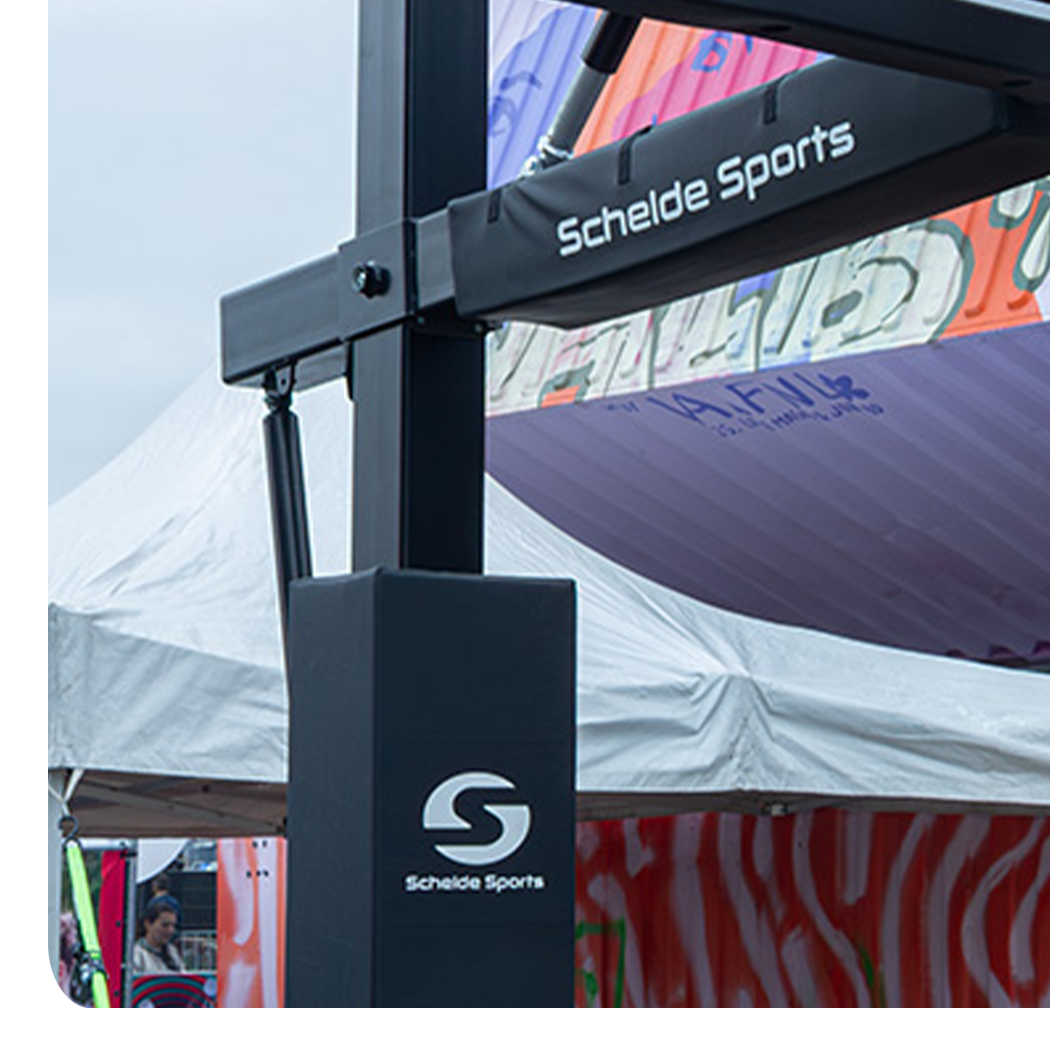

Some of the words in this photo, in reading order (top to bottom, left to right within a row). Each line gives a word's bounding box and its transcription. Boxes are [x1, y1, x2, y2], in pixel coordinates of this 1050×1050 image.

[556, 180, 710, 257] Schelde
[716, 121, 856, 202] Sports
[405, 874, 482, 892] Schelde
[484, 873, 545, 894] Sports
